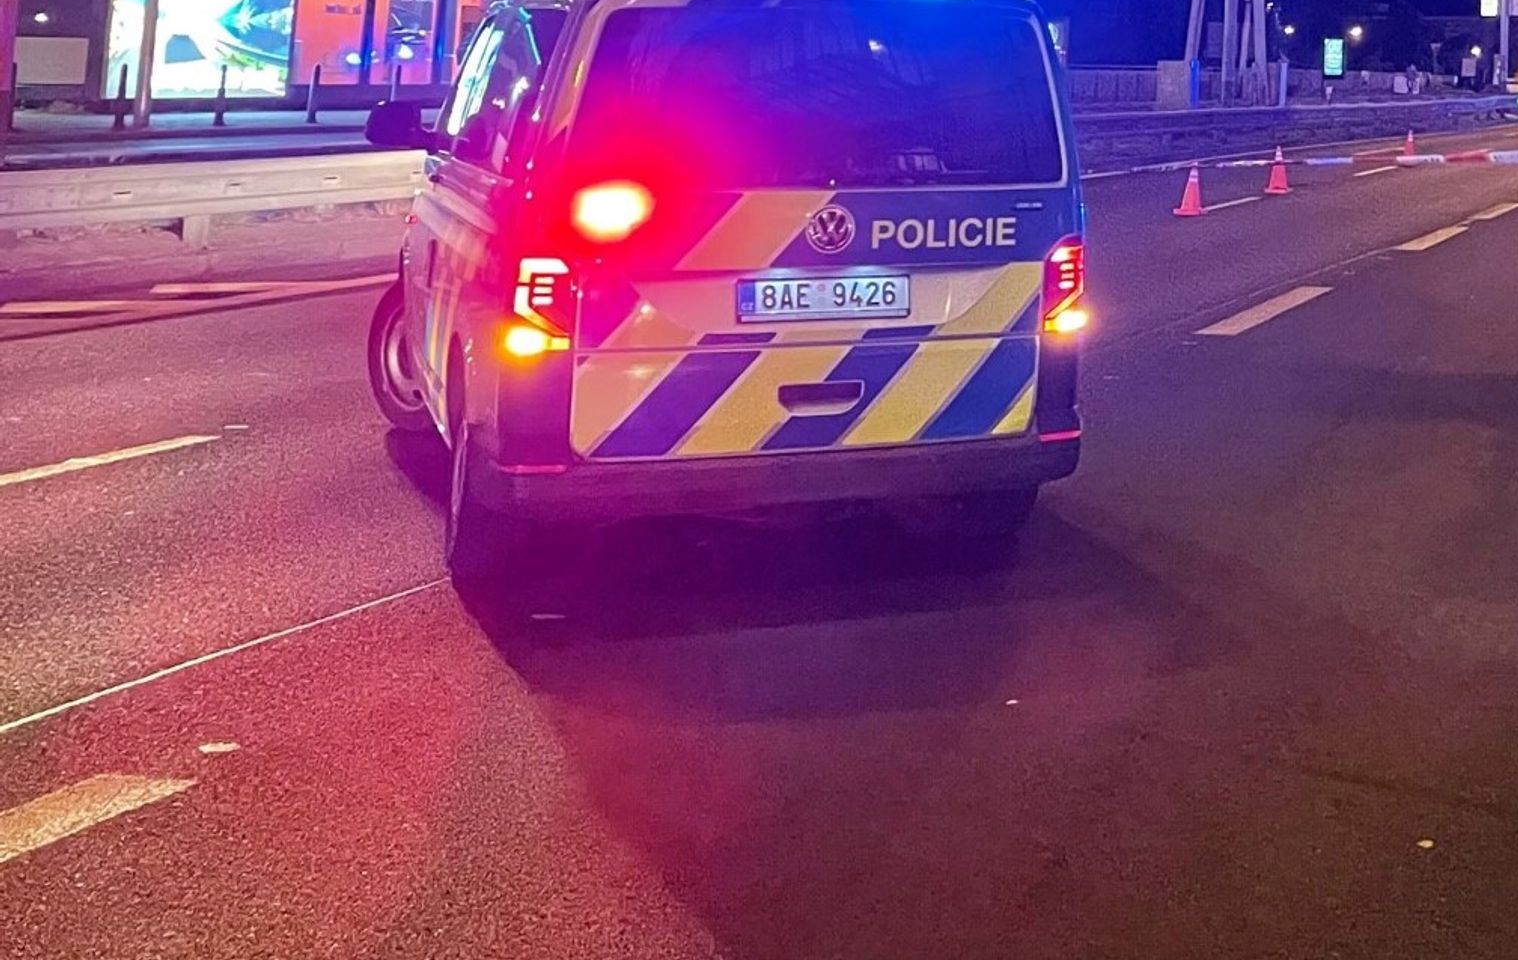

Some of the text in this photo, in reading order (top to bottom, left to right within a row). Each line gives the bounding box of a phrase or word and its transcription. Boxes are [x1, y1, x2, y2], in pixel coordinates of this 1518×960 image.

[871, 216, 1017, 249] POLICIE
[761, 280, 897, 311] 8AE 9426
